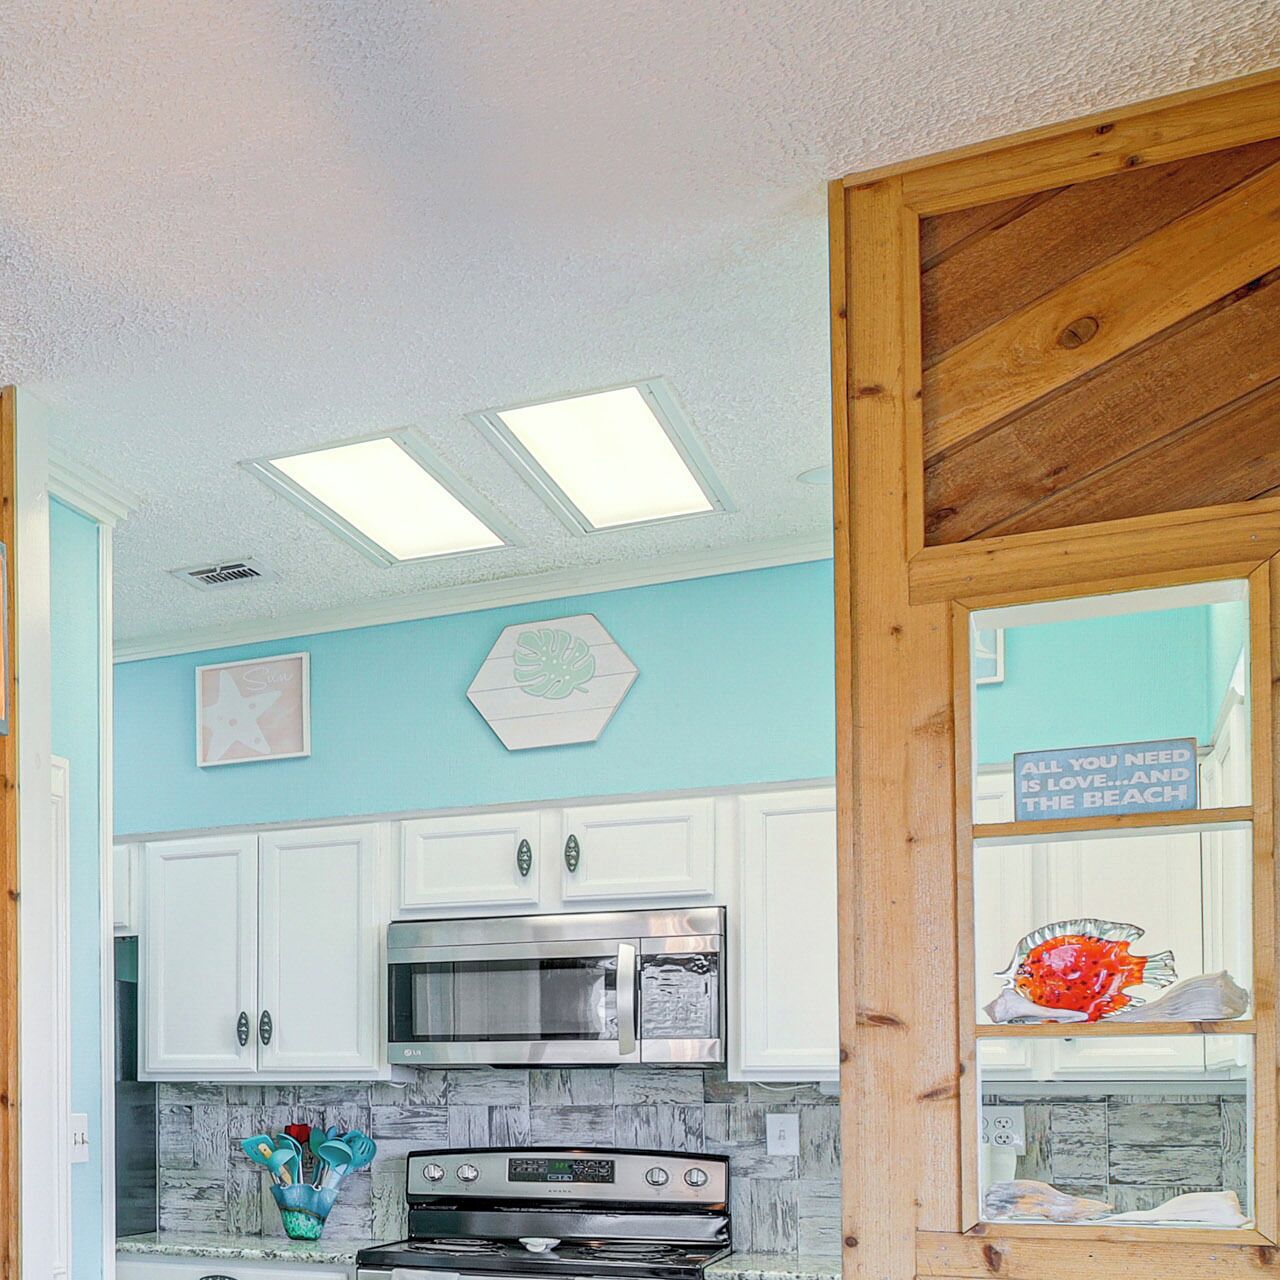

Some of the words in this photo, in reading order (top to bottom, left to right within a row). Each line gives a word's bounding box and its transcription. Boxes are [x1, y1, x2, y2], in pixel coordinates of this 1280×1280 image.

[1021, 759, 1063, 775] ALL
[1068, 754, 1118, 771] YOU
[1124, 748, 1191, 767] NEED
[1021, 779, 1041, 793] IS
[1022, 795, 1075, 812] THE
[1083, 784, 1188, 808] BEACH
